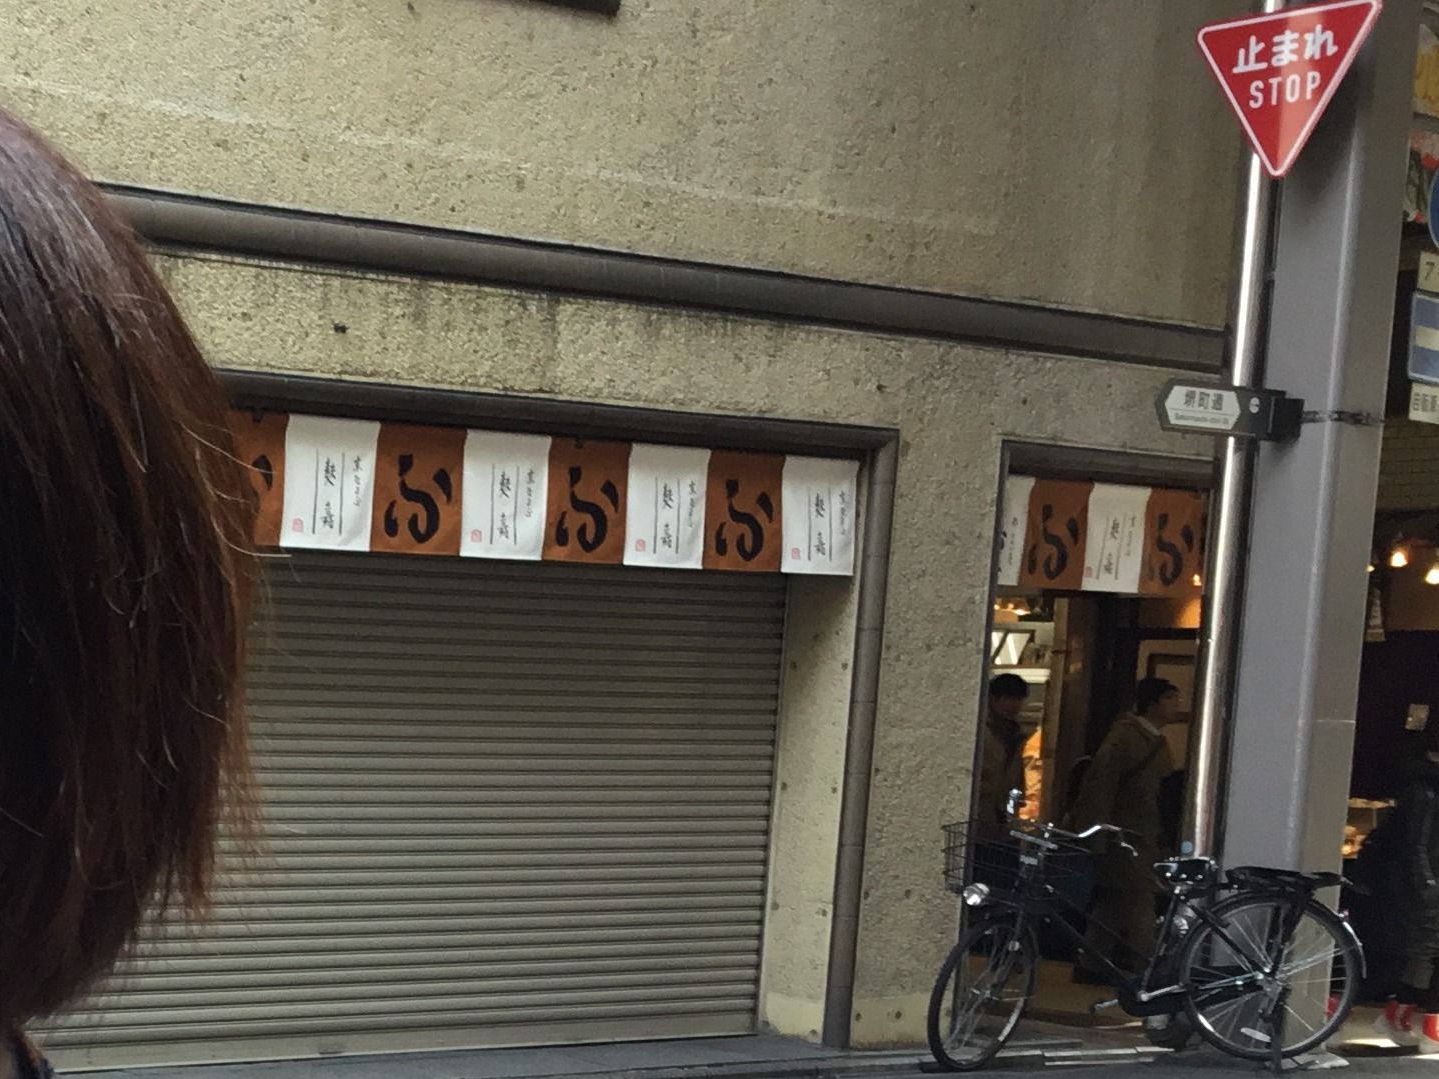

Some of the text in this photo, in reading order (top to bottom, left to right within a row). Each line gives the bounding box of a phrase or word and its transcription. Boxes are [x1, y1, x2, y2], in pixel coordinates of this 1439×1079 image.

[1232, 25, 1338, 73] 止まれ
[1249, 71, 1321, 109] STOP
